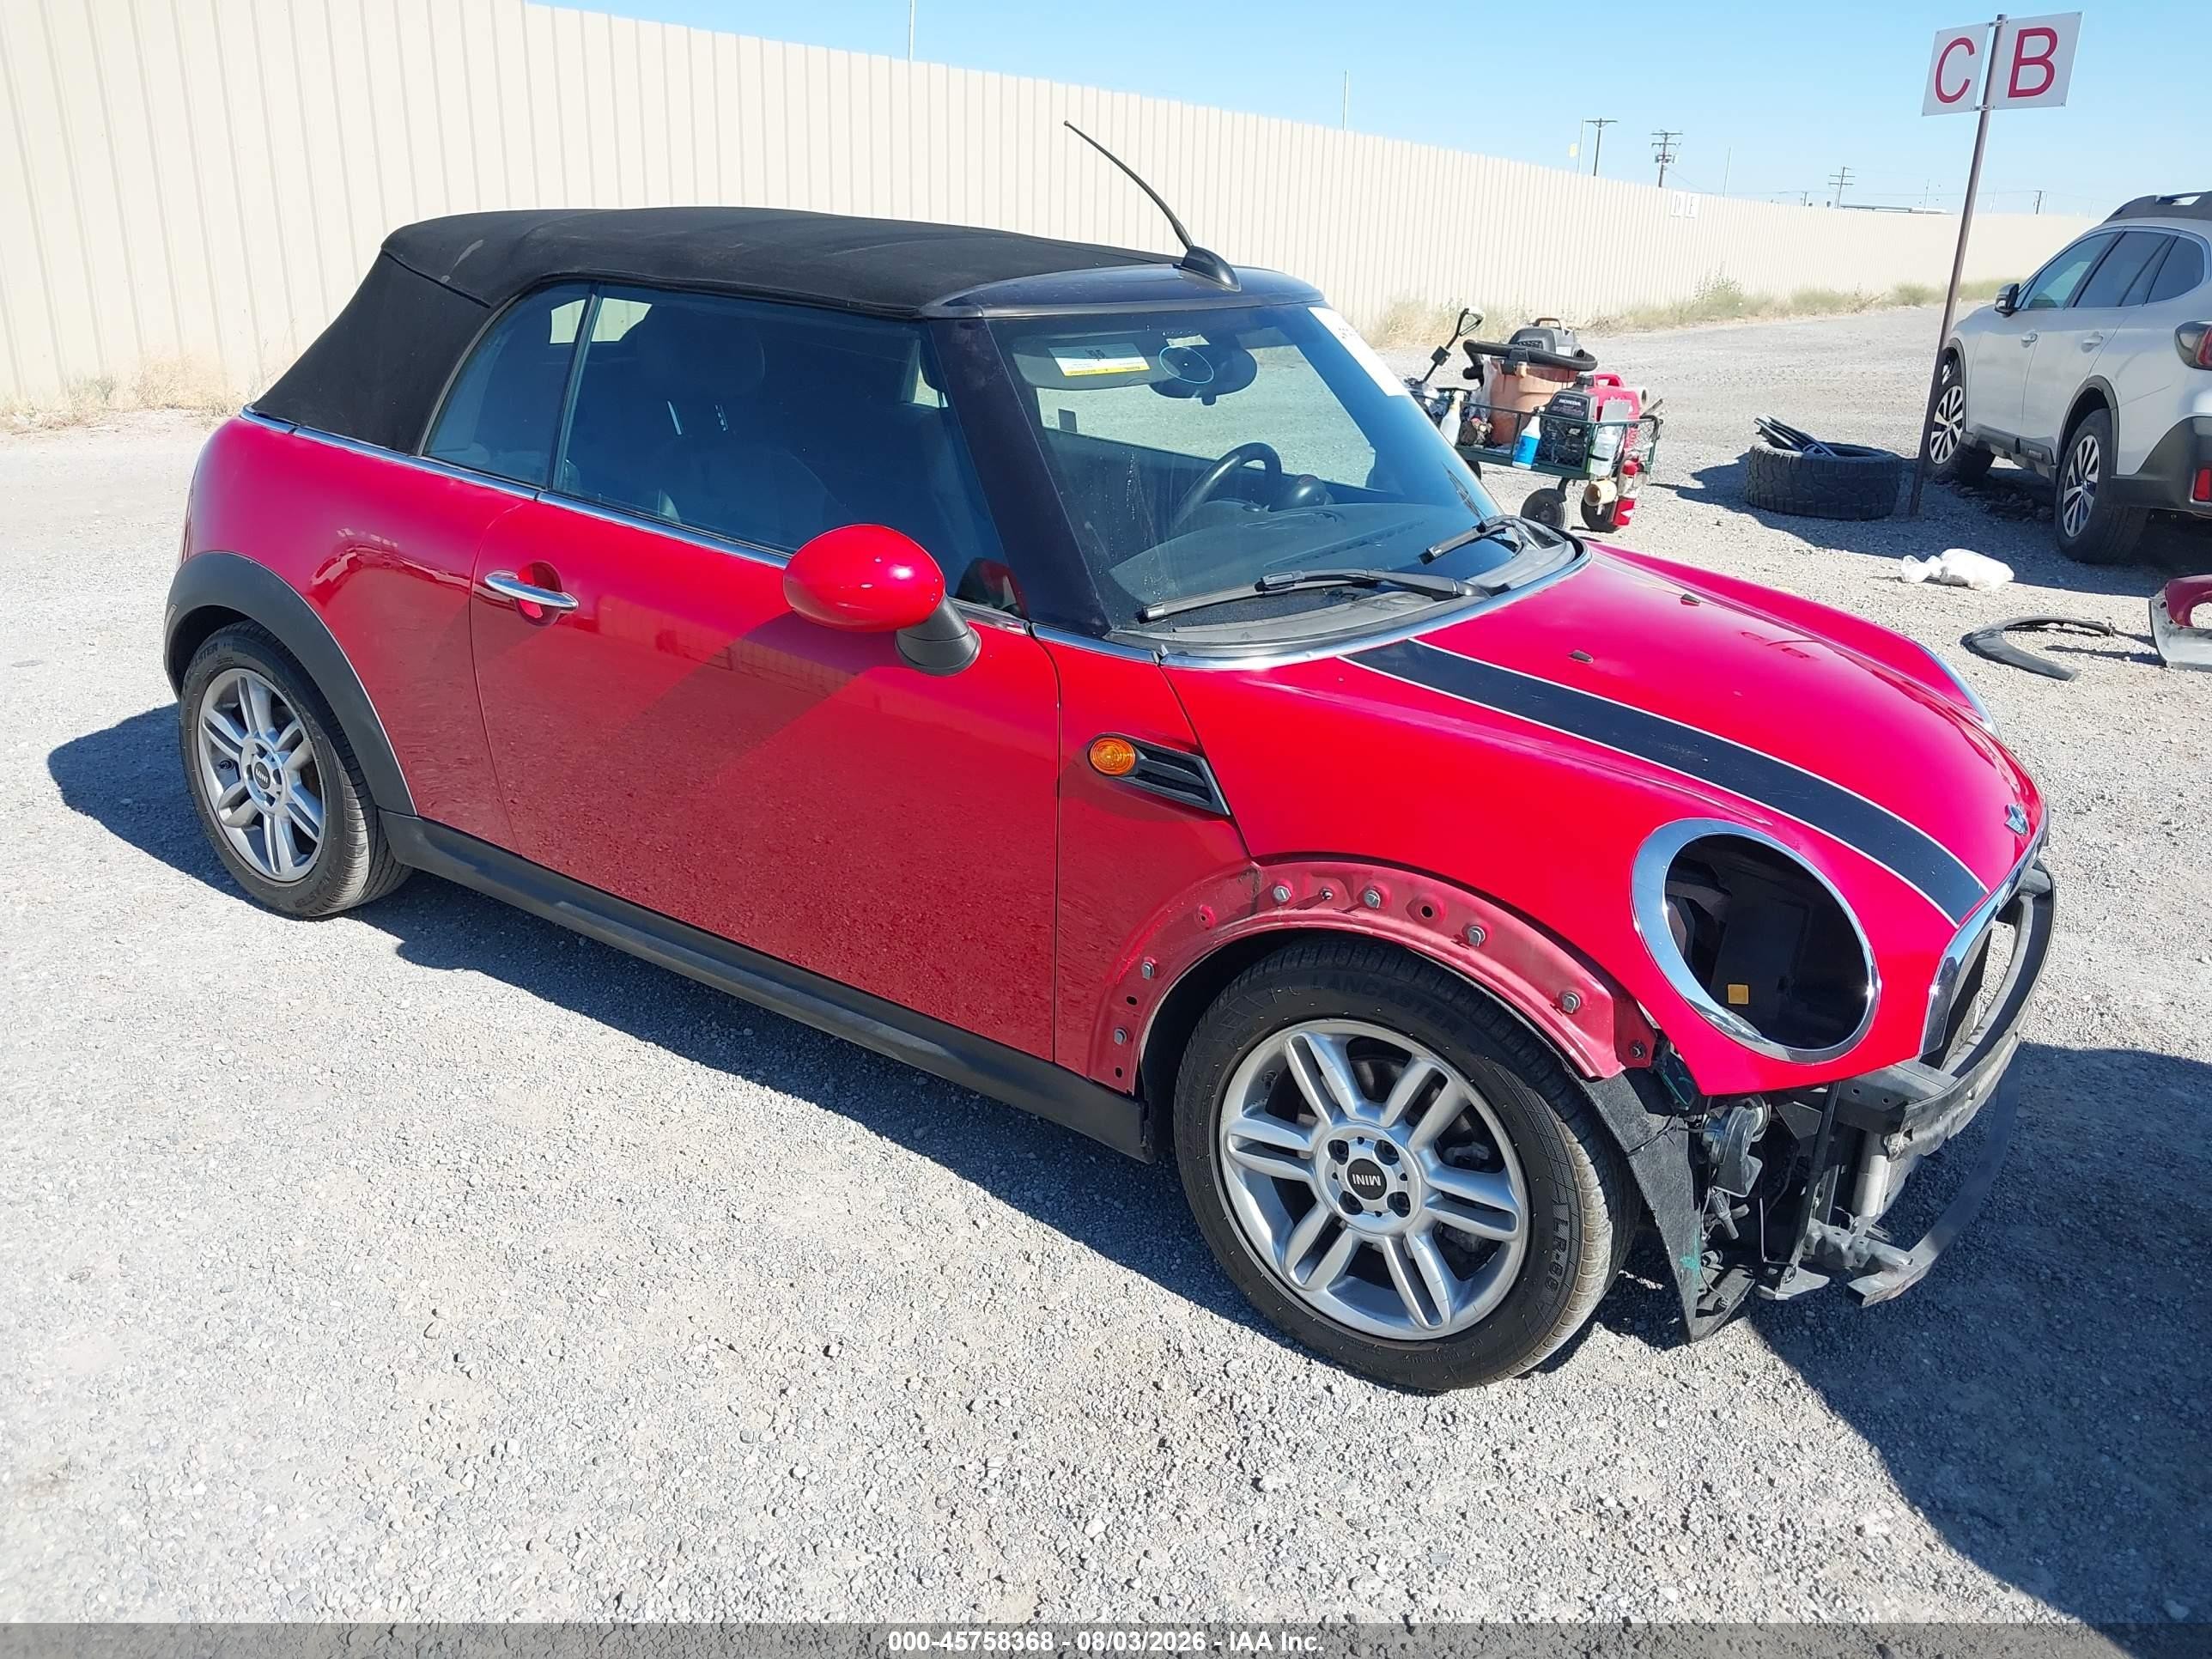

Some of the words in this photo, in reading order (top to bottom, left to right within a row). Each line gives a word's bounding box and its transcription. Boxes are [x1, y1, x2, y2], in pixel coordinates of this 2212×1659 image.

[1935, 37, 1975, 103] C
[2008, 27, 2058, 98] B
[1352, 1173, 1382, 1187] MINI
